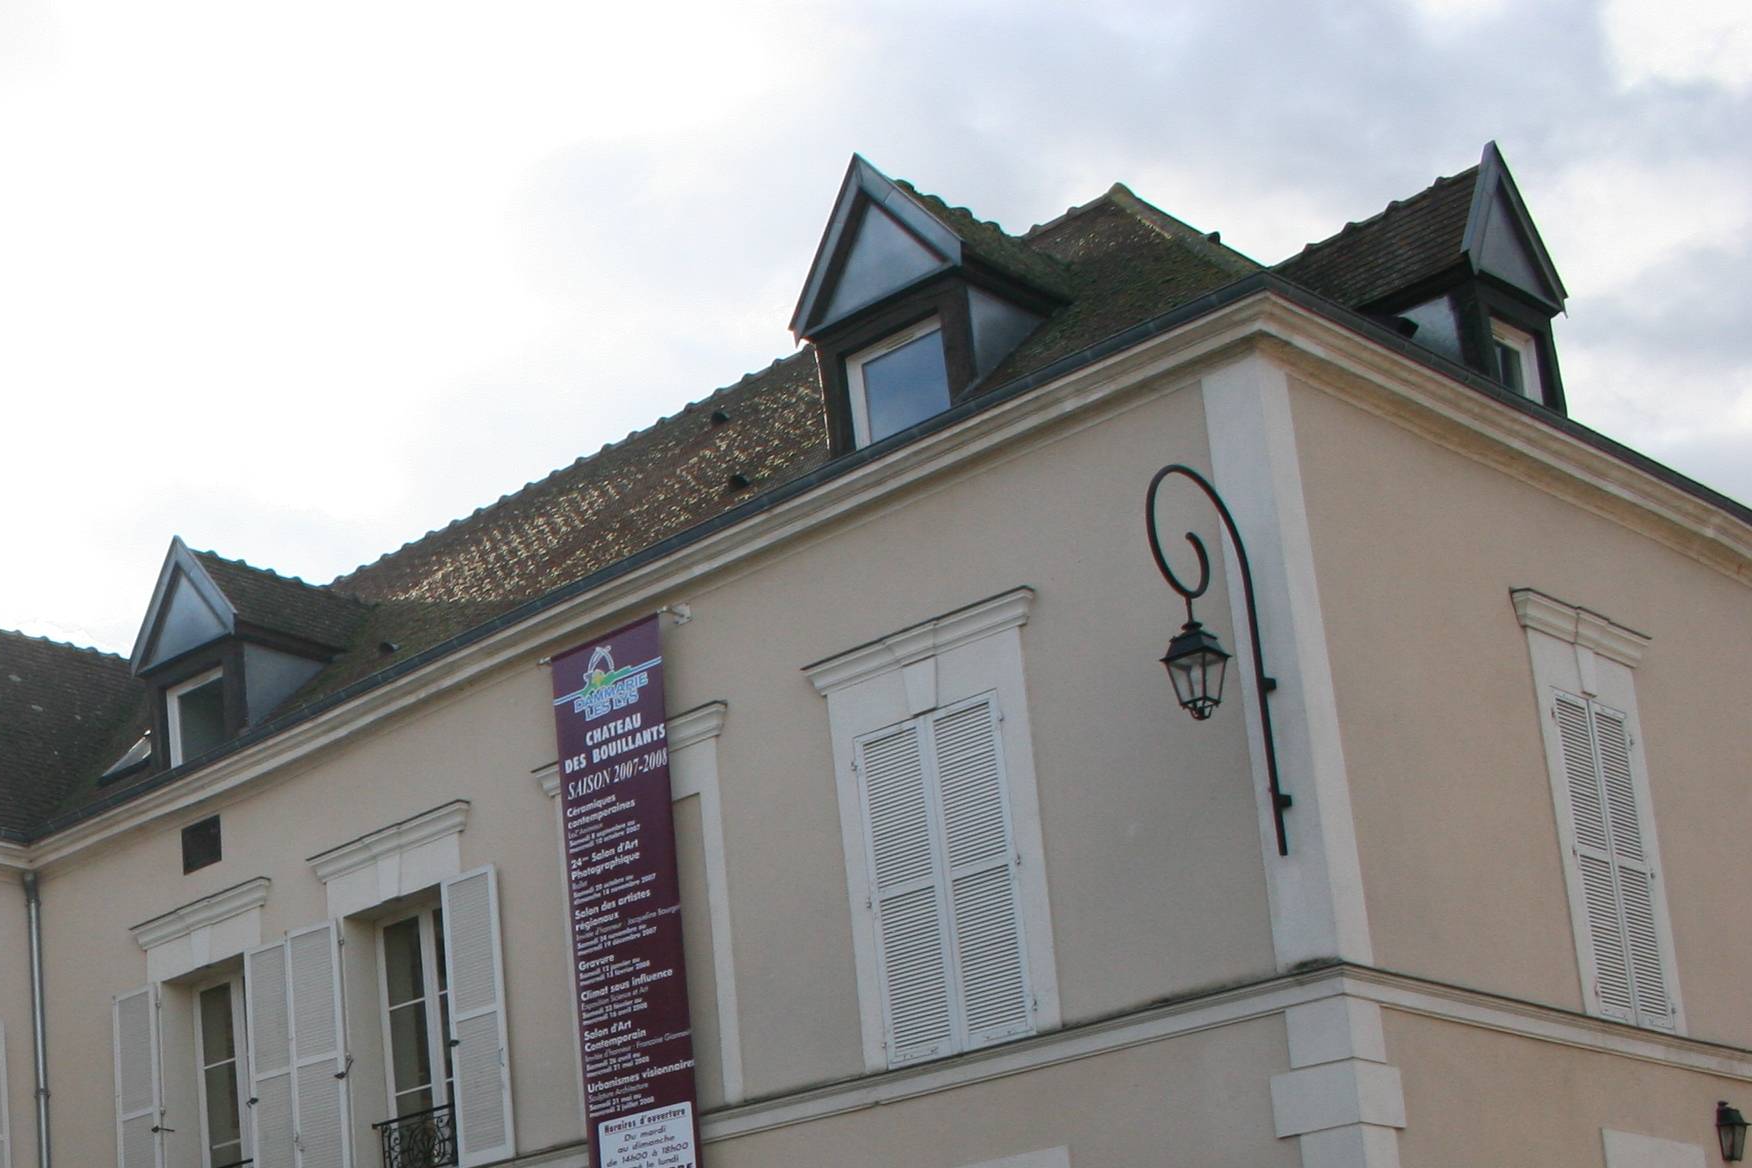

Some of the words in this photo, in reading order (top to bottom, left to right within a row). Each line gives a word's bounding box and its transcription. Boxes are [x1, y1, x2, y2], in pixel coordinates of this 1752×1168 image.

[574, 671, 649, 713] DAMMARIE
[585, 698, 611, 721] LES
[612, 688, 639, 710] LYS
[585, 713, 642, 746] CHATEAU
[564, 753, 586, 774] DES
[592, 723, 666, 764] BOUILLANTS
[568, 767, 611, 800] SAISON
[613, 747, 668, 783] 2007-2008
[568, 799, 636, 829] contemporaines
[591, 847, 615, 862] Salon
[616, 838, 639, 853] d'Art
[571, 852, 641, 881] Photographique
[574, 905, 599, 921] Salon
[600, 898, 617, 912] des
[617, 889, 652, 906] artistes
[575, 911, 619, 932] régionaux
[580, 985, 609, 1001] Climat
[609, 980, 631, 994] sous
[631, 968, 673, 986] influence
[584, 1026, 609, 1041] Salon
[610, 1020, 632, 1035] d'Art
[584, 1028, 647, 1052] Contemporain
[588, 1073, 640, 1093] Urbanismes
[641, 1056, 697, 1079] visionnaires
[604, 1118, 636, 1135] Horaires
[639, 1107, 686, 1126] d'ouverture
[624, 1133, 637, 1143] Du
[640, 1124, 667, 1138] mardi
[606, 1158, 618, 1168] de
[622, 1150, 648, 1164] 14h00
[662, 1141, 689, 1155] 18h00
[617, 1146, 629, 1154] au
[632, 1134, 676, 1152] dimanche
[646, 1159, 655, 1168] le
[658, 1153, 680, 1167] lundi
